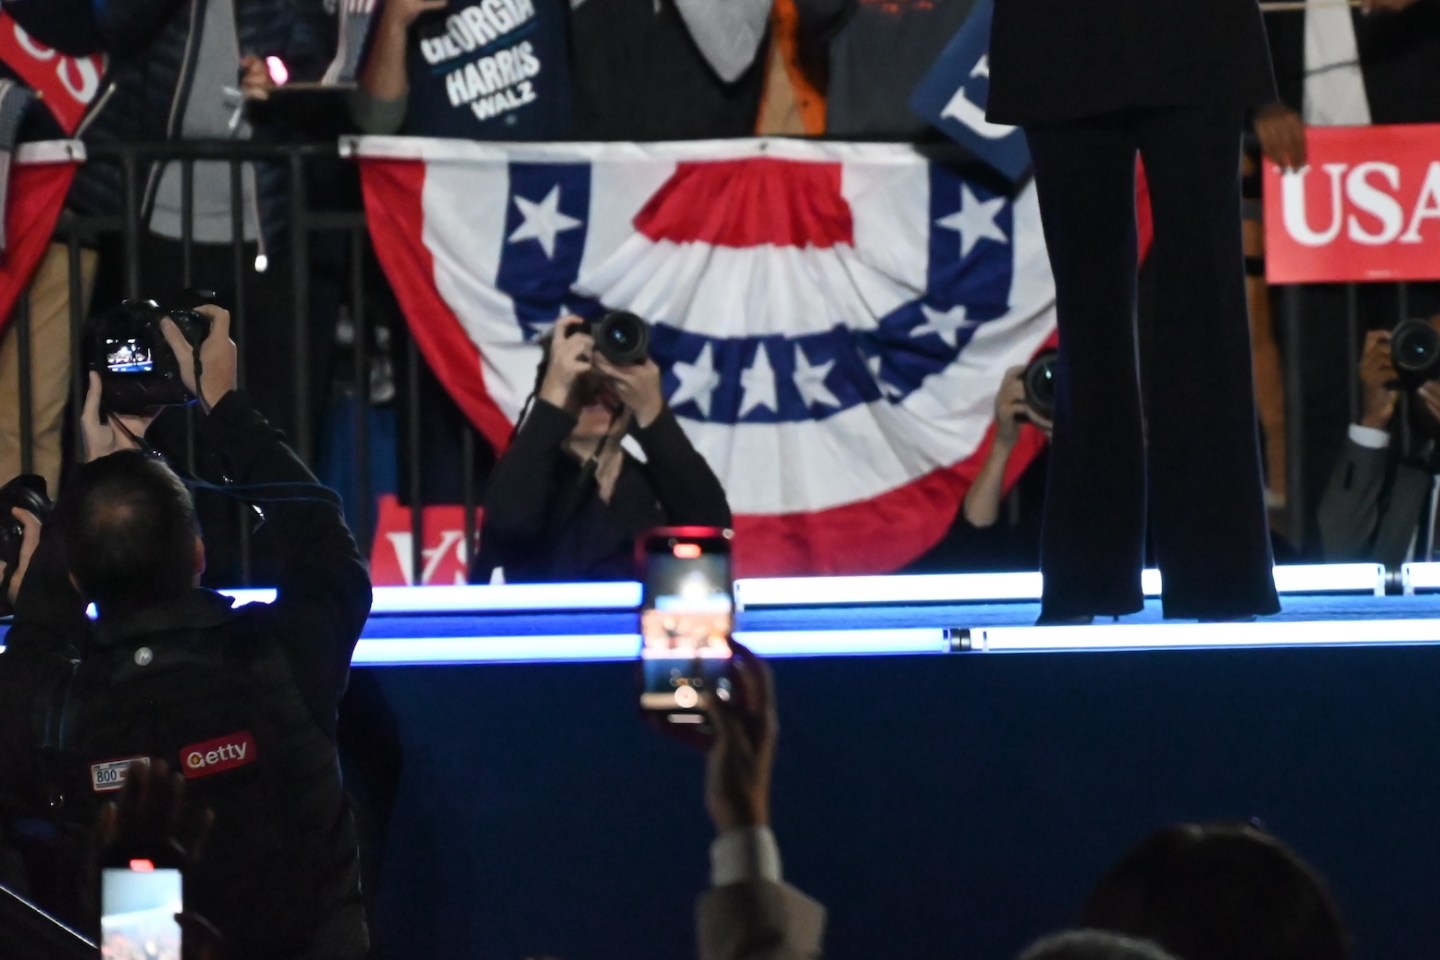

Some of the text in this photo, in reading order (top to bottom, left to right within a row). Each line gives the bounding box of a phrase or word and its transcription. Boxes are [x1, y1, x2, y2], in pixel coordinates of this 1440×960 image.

[445, 40, 541, 107] HARRIS
[471, 80, 538, 121] WALZ
[187, 741, 248, 769] Getty
